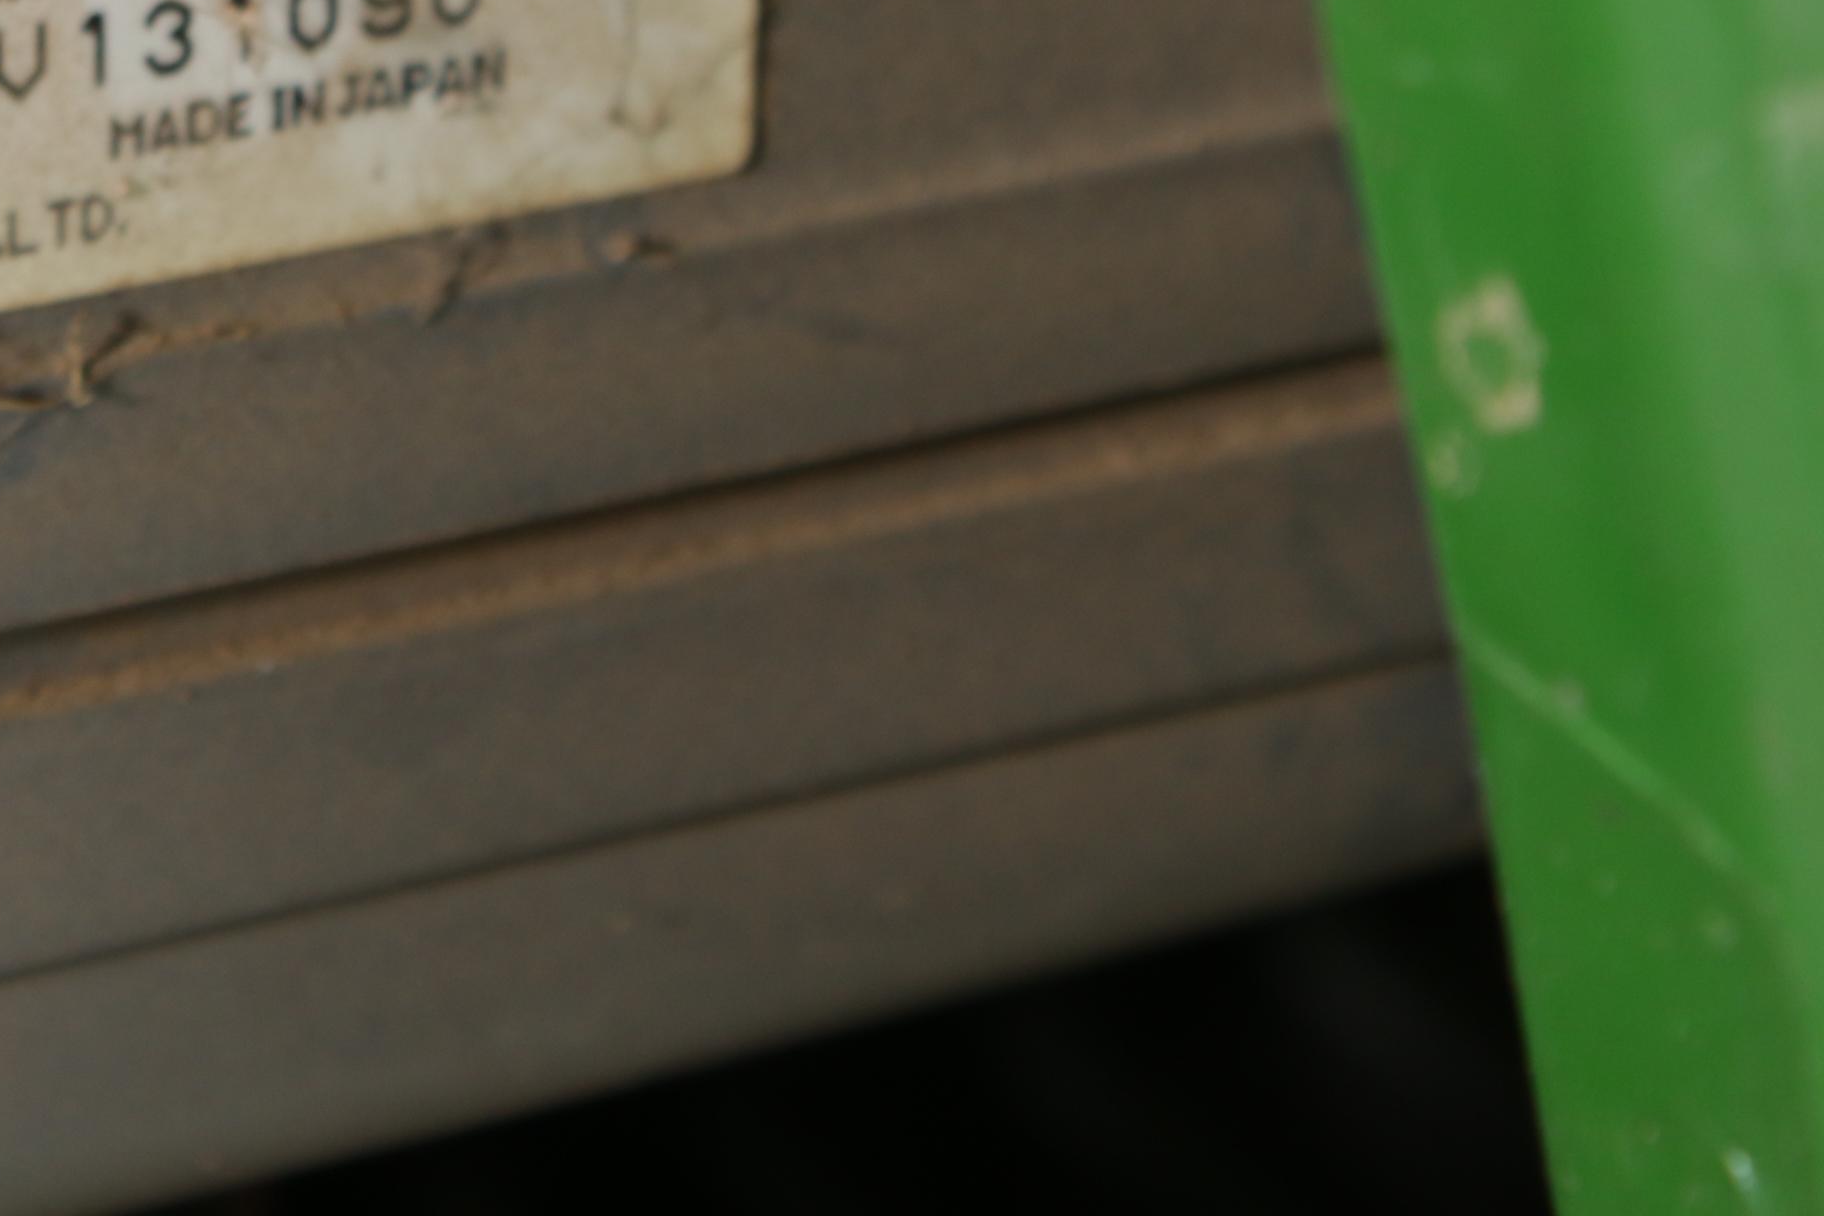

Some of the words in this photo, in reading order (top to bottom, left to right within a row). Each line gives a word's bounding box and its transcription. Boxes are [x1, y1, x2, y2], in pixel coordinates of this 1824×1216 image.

[110, 92, 253, 159] MADE
[272, 84, 326, 131] IN
[336, 48, 508, 118] JAPAN
